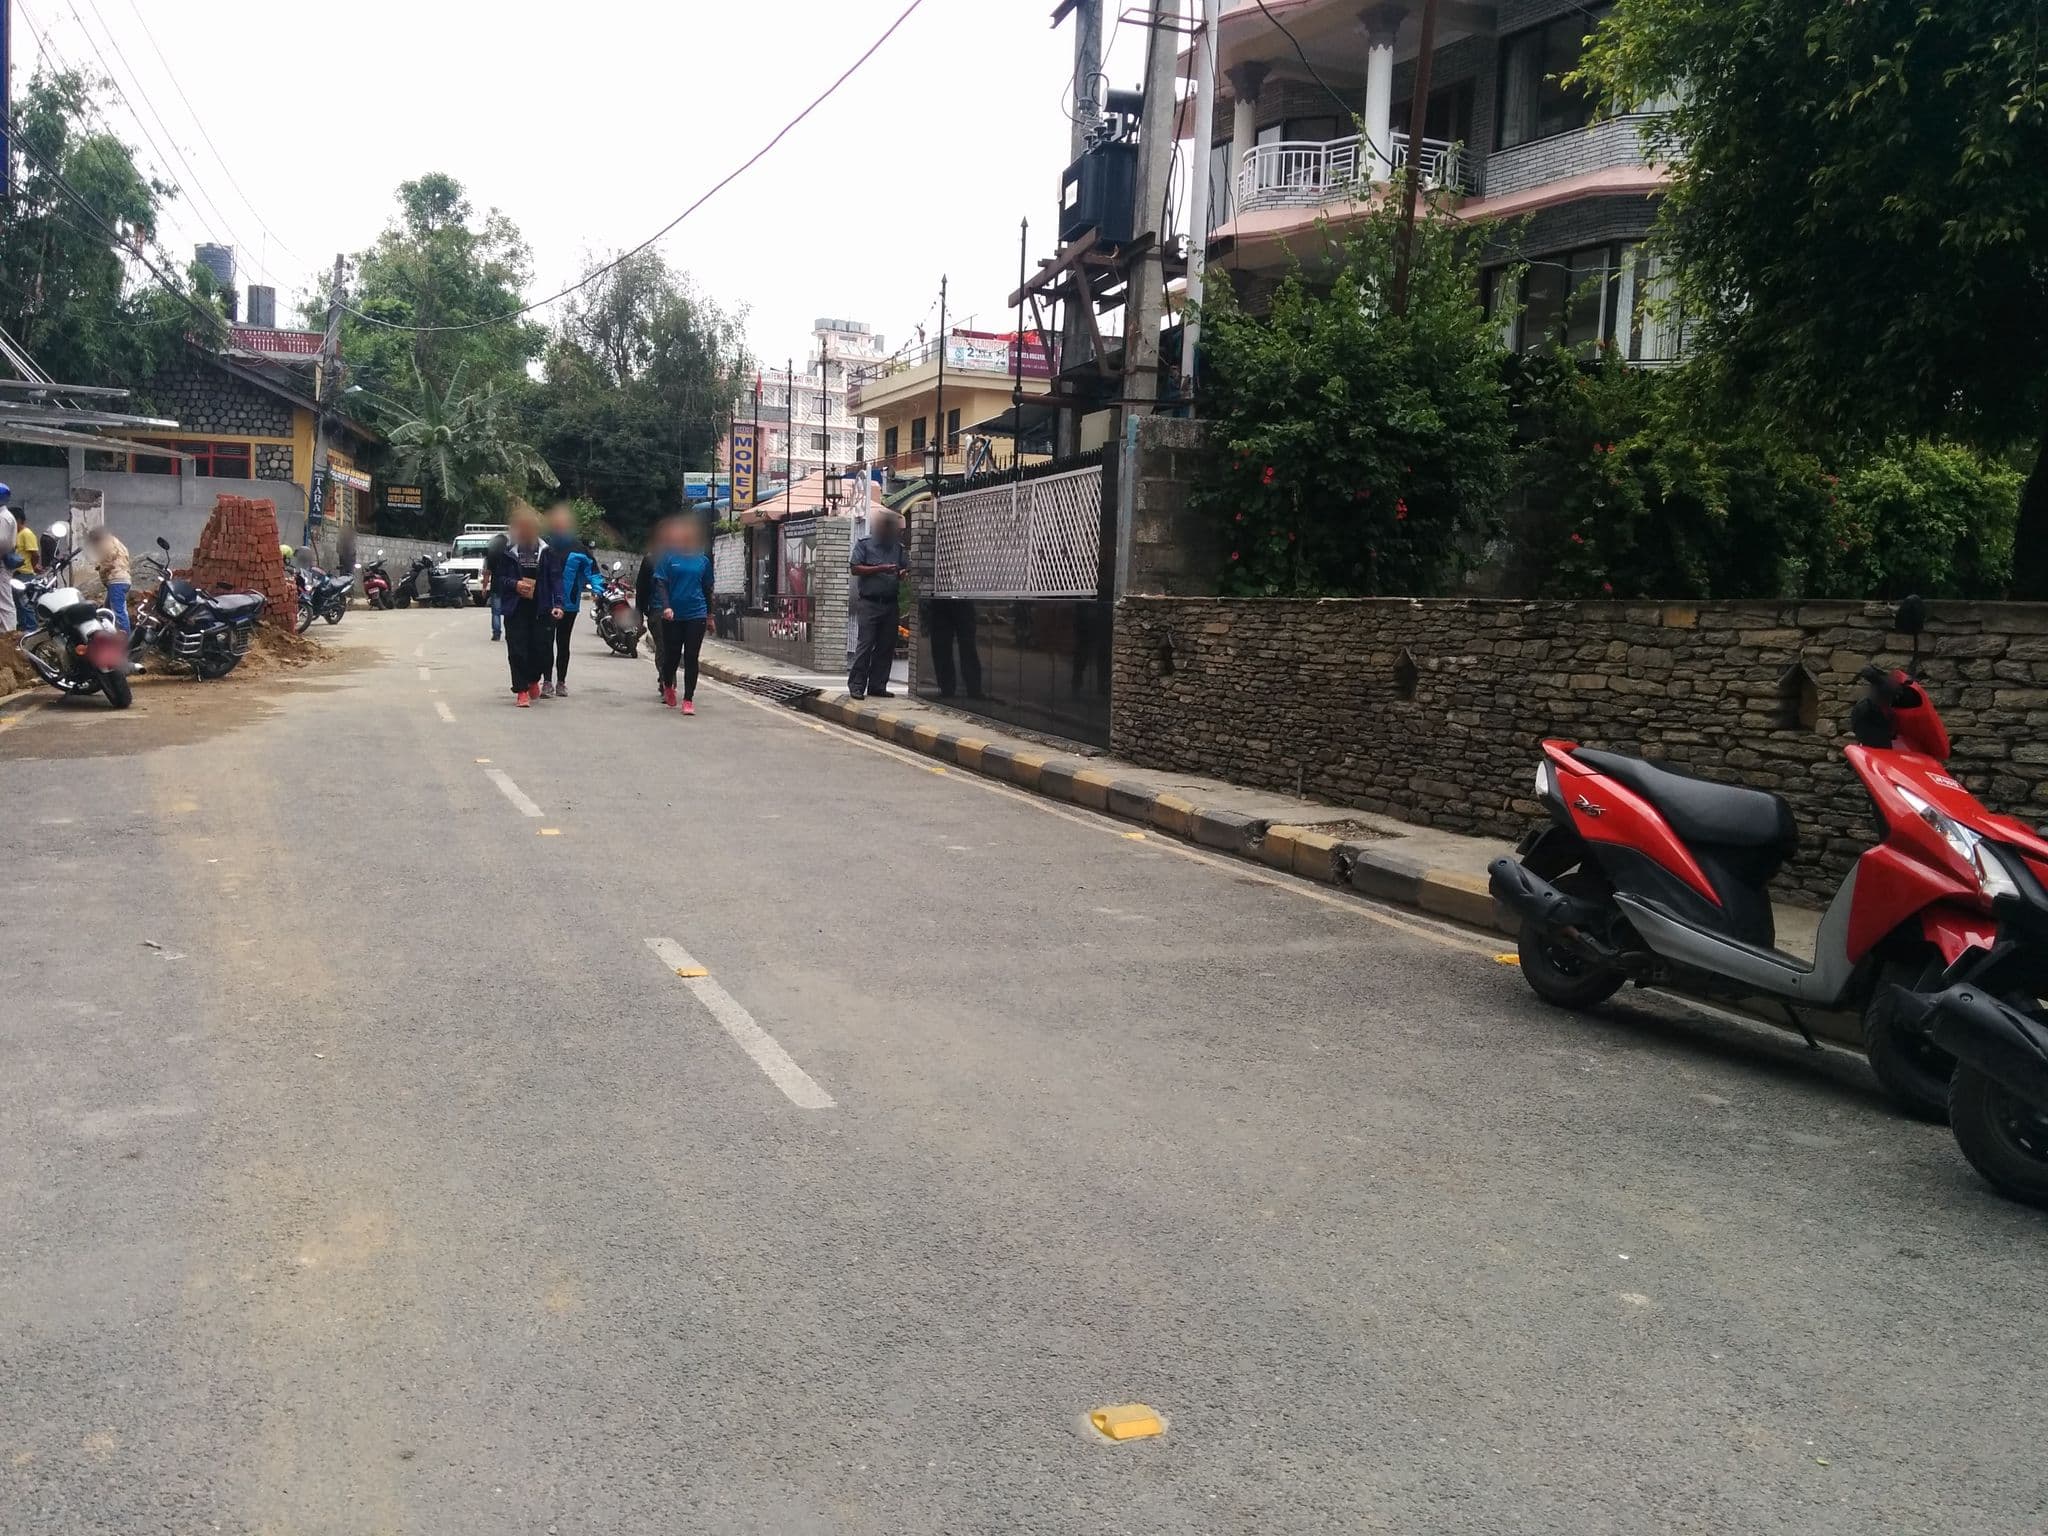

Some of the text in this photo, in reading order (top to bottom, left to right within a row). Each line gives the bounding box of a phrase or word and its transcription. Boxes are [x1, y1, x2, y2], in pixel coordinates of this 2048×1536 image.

[967, 347, 975, 358] 2
[735, 436, 753, 500] MONEY
[349, 476, 369, 487] HOUSE
[312, 477, 324, 512] TARA
